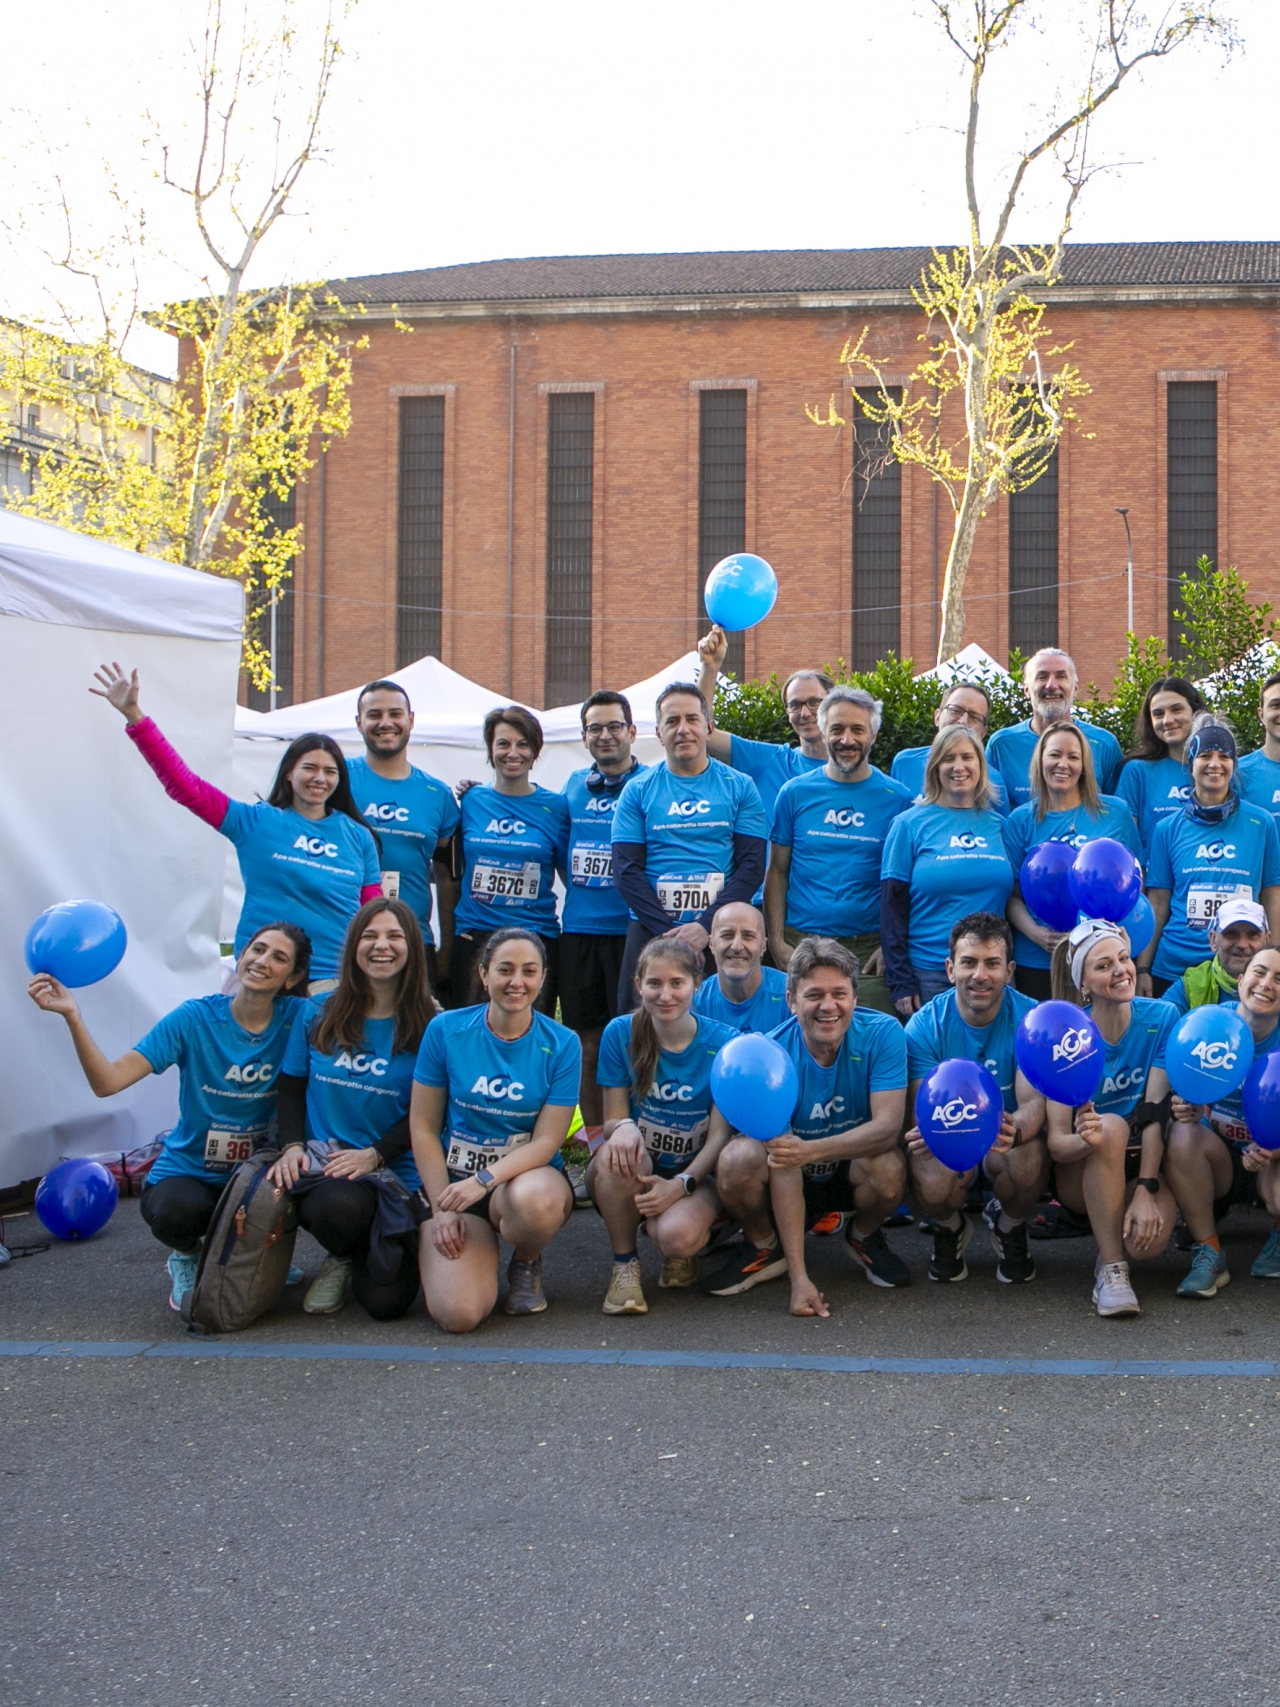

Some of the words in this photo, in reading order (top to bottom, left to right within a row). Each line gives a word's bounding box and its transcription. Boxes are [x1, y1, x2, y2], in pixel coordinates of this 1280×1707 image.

[1167, 786, 1190, 800] AC
[487, 874, 524, 896] 367C
[673, 890, 710, 909] 370A
[1052, 1028, 1092, 1062] ACC
[1190, 1040, 1238, 1070] ACC
[931, 1100, 978, 1126] ACC
[226, 1140, 251, 1161] 36
[651, 1131, 693, 1154] 368A
[804, 1161, 837, 1175] 384
